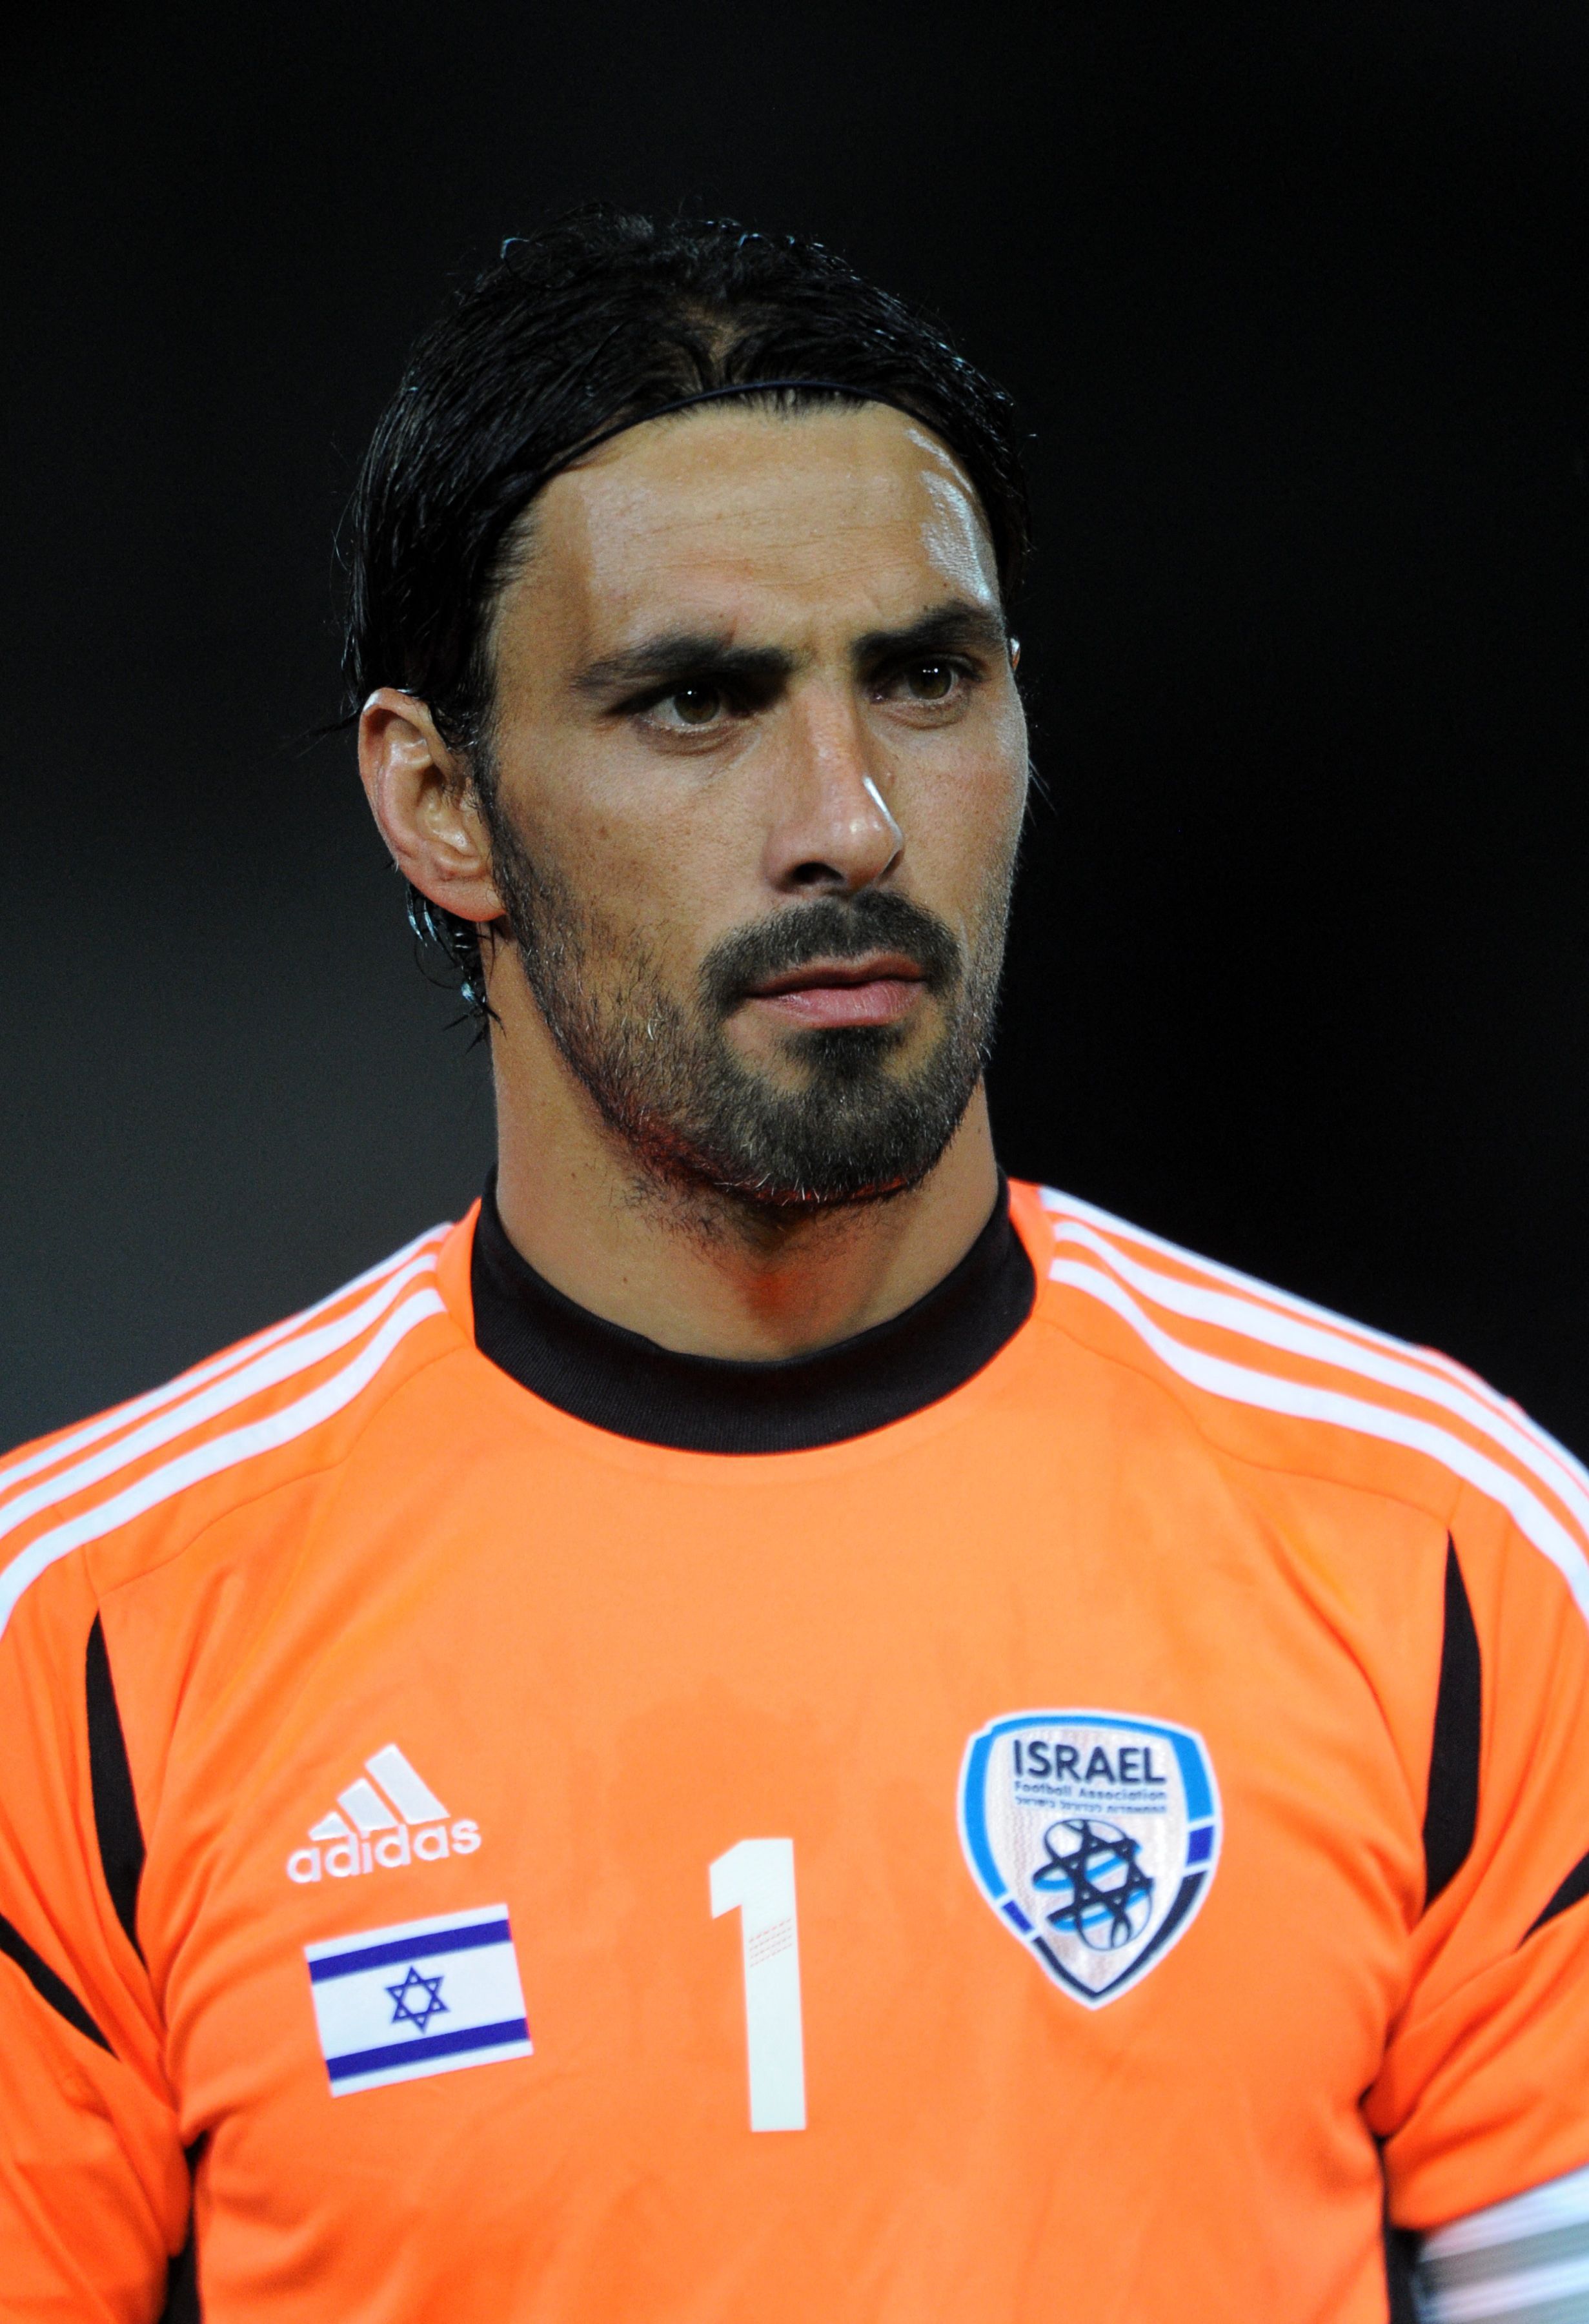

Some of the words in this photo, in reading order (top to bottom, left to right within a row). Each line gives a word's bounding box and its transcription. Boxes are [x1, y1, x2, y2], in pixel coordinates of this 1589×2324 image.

[1014, 1739, 1166, 1784] ISRAEL
[1014, 1780, 1072, 1797] Football
[1079, 1787, 1167, 1801] Association
[287, 1819, 482, 1883] adidas
[709, 1838, 807, 2132] 1
